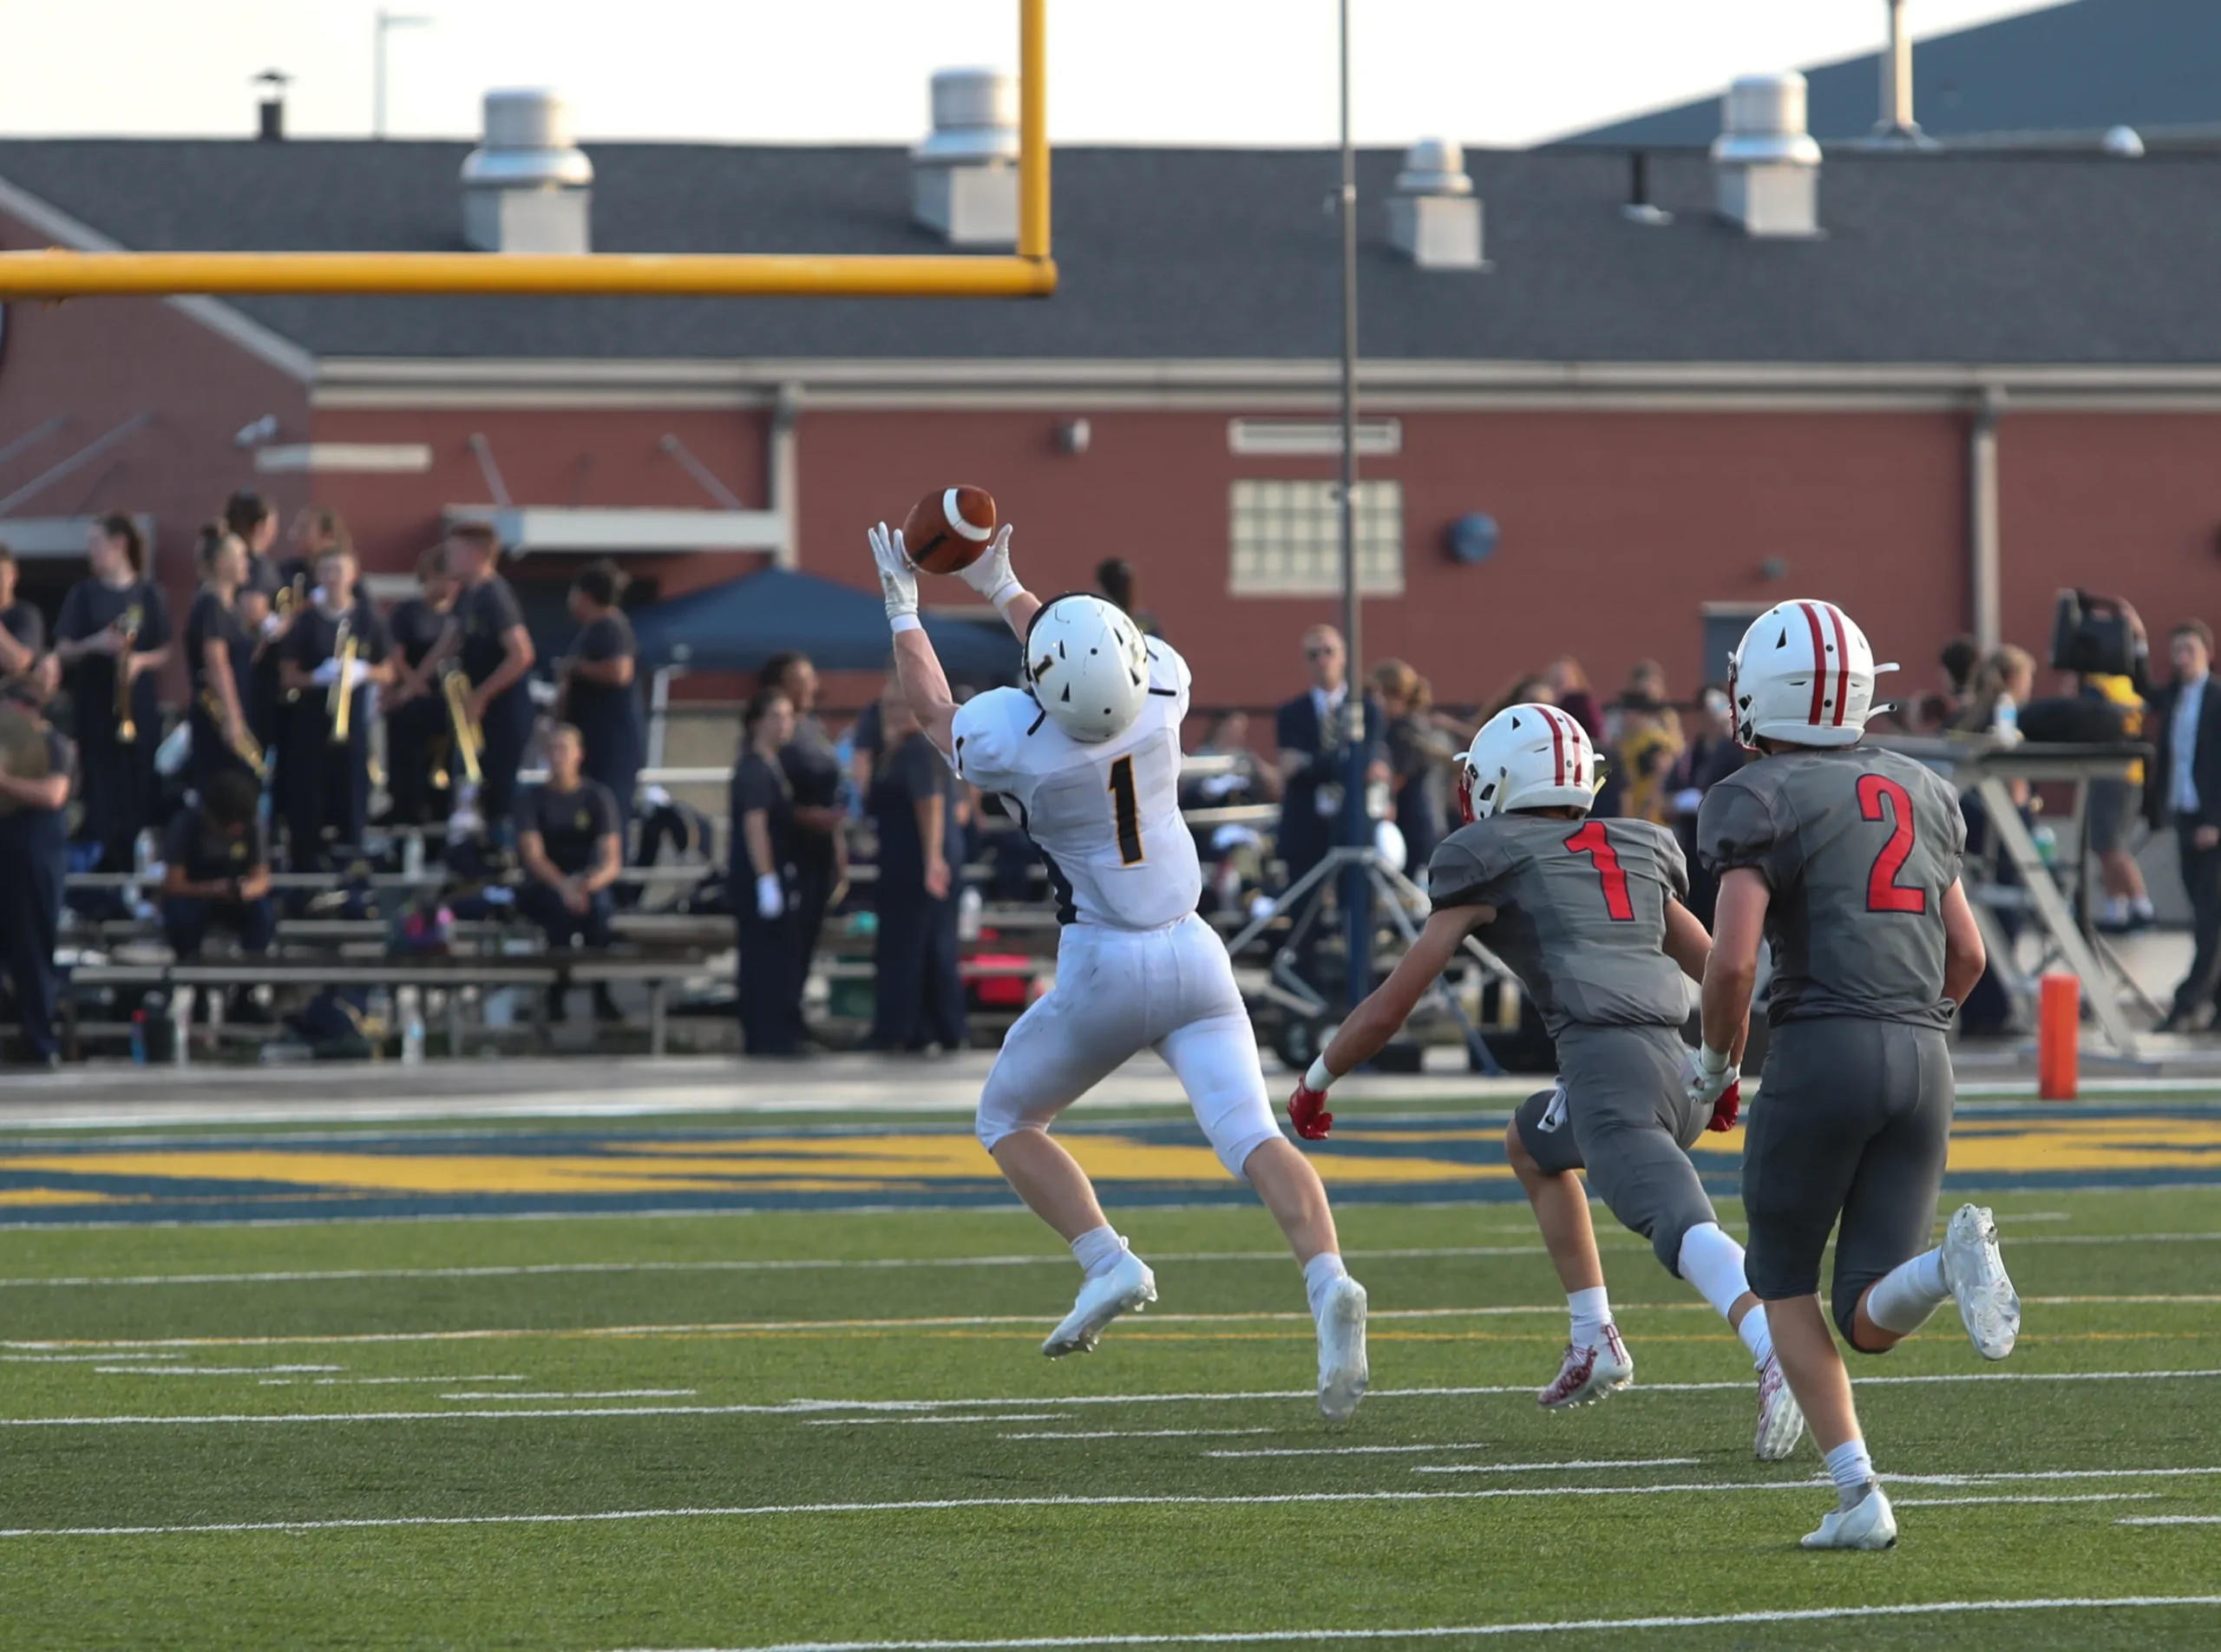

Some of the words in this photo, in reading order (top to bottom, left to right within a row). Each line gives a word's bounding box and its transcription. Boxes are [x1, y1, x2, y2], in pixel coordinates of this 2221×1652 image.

[1108, 753, 1145, 866] 1
[1856, 772, 1925, 915] 2
[1563, 820, 1635, 921] 1
